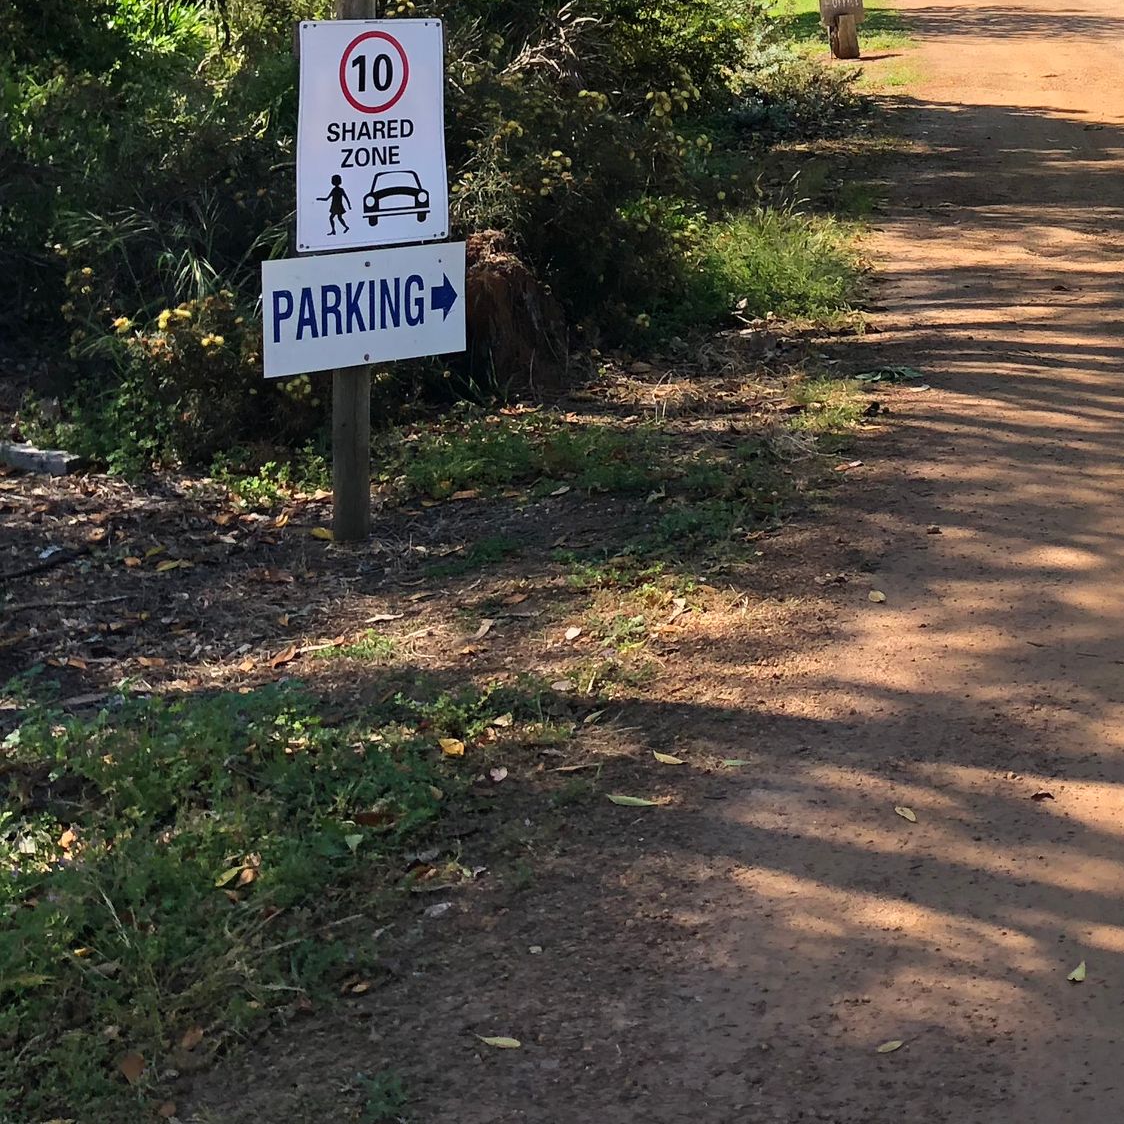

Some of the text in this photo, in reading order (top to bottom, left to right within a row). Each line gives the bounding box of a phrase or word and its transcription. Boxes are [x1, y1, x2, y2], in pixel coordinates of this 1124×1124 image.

[351, 53, 393, 93] 10
[327, 119, 414, 142] SHARED
[340, 146, 400, 168] ZONE
[272, 274, 425, 343] PARKING
